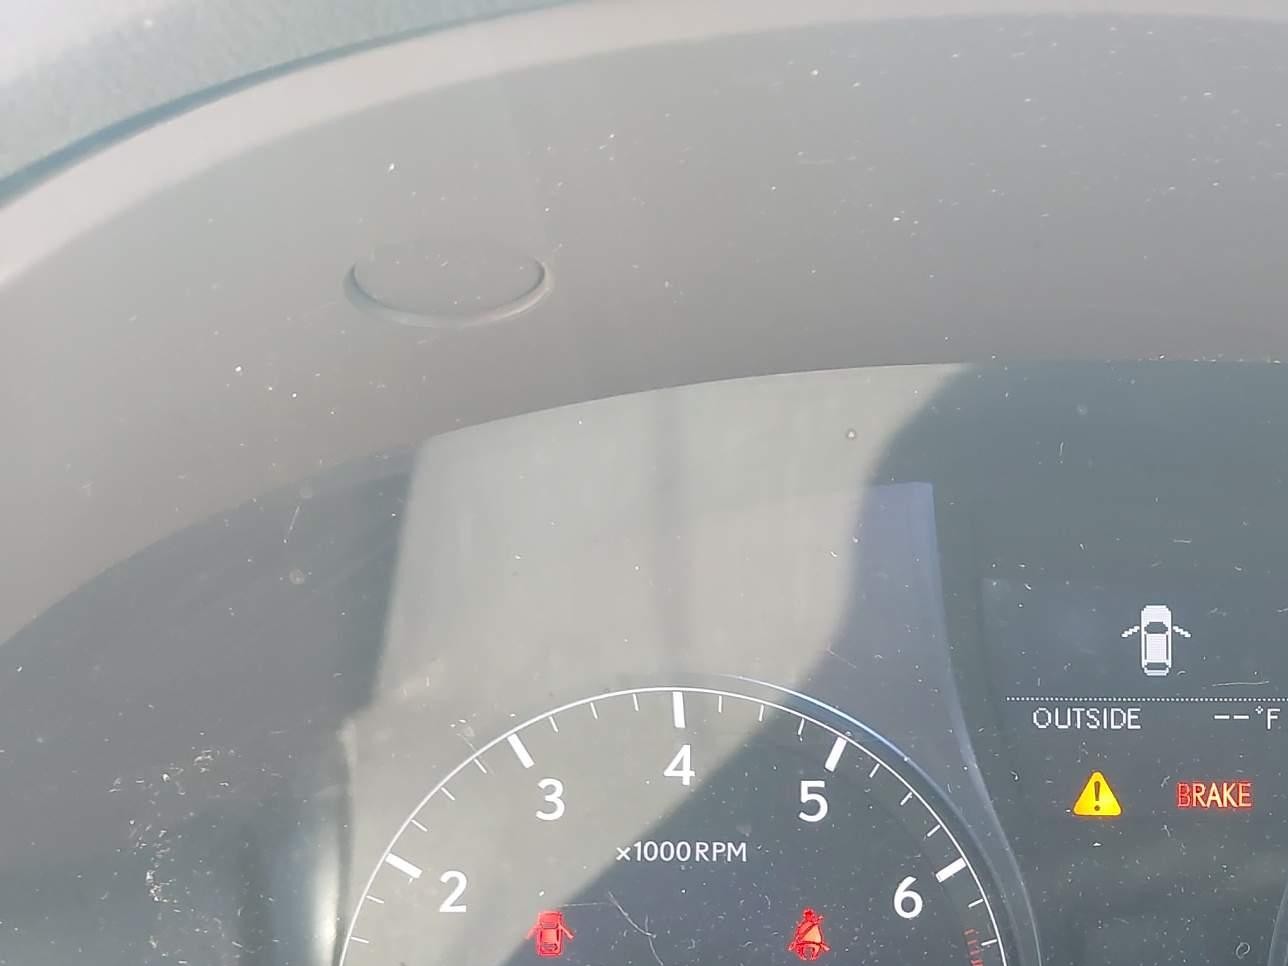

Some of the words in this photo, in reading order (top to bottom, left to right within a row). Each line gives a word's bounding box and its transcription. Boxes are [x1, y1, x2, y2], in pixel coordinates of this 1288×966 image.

[1032, 707, 1141, 730] OUTSIDE
[663, 744, 695, 786] 4
[537, 779, 565, 820] 3
[798, 780, 828, 823] 5
[1176, 782, 1253, 808] BRAKE
[695, 841, 747, 863] RPM
[439, 872, 468, 913] 2
[893, 876, 923, 918] 6
